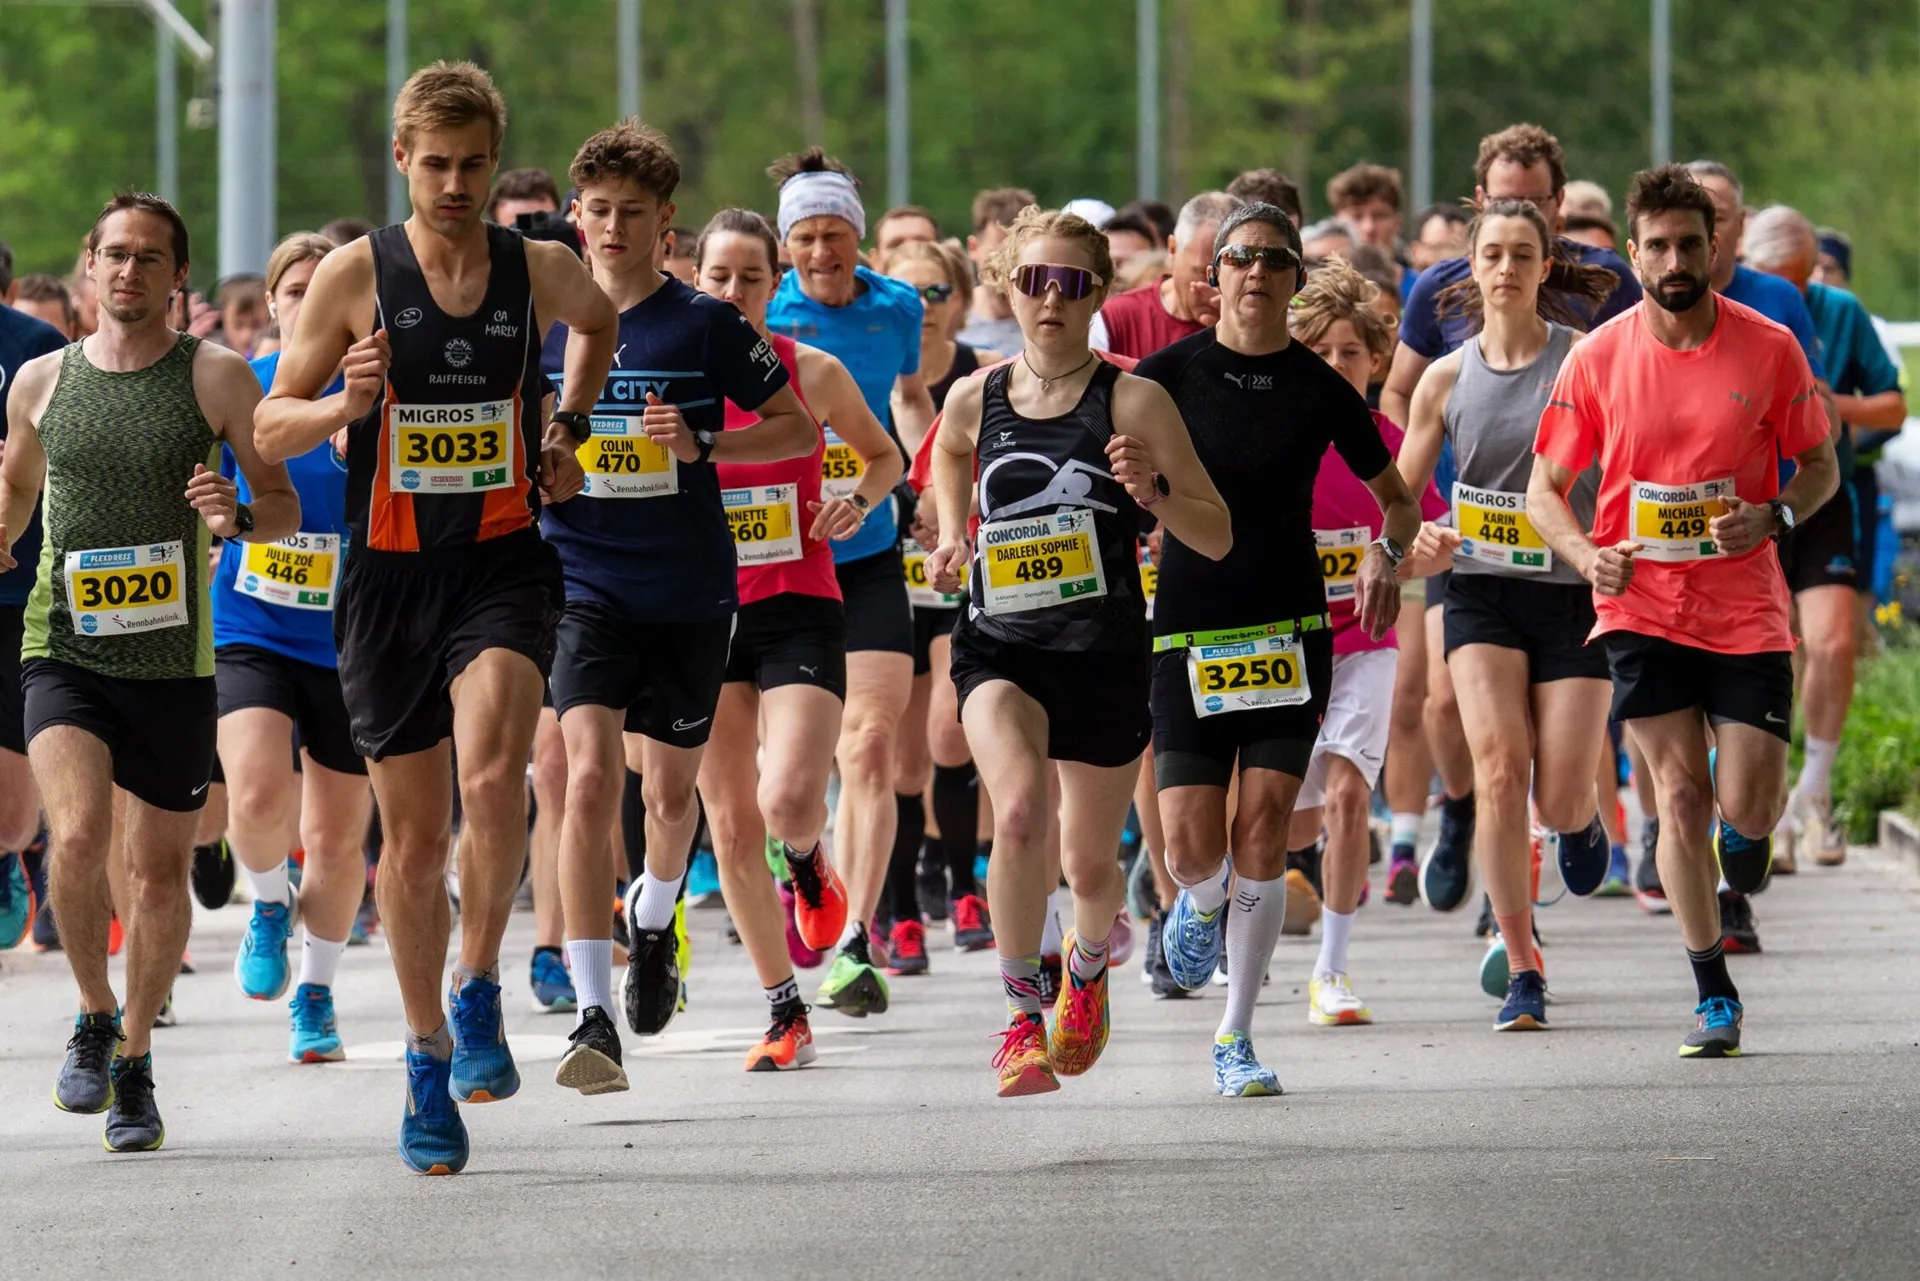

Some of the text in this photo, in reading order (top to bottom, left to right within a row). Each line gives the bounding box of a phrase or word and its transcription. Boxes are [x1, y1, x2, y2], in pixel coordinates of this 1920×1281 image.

[494, 310, 508, 322] CA
[485, 324, 518, 337] MARLY
[429, 374, 487, 385] RAIFFEISEN
[612, 380, 670, 401] CITY
[399, 408, 474, 423] MIGROS
[407, 430, 499, 463] 3033
[601, 440, 634, 453] COLIN
[827, 447, 850, 459] NILS
[596, 454, 641, 473] 470
[822, 460, 857, 479] 455
[616, 482, 670, 493] Rennbahnklinik
[1458, 488, 1516, 508] MIGROS
[1483, 511, 1516, 526] KARIN
[1658, 506, 1707, 519] MICHAEL
[1479, 524, 1520, 545] 448
[1660, 519, 1706, 538] 449
[90, 553, 131, 563] FLEXDRESS
[265, 548, 315, 567] JULIE ZOÉ
[997, 544, 1040, 562] DARLEEN
[1041, 538, 1080, 555] SOPHIE
[266, 562, 309, 585] 446
[1015, 556, 1064, 582] 489
[81, 571, 172, 607] 3020
[127, 613, 179, 629] Rennbahnklinik
[1213, 630, 1264, 642] CRESPO
[1205, 658, 1293, 690] 3250
